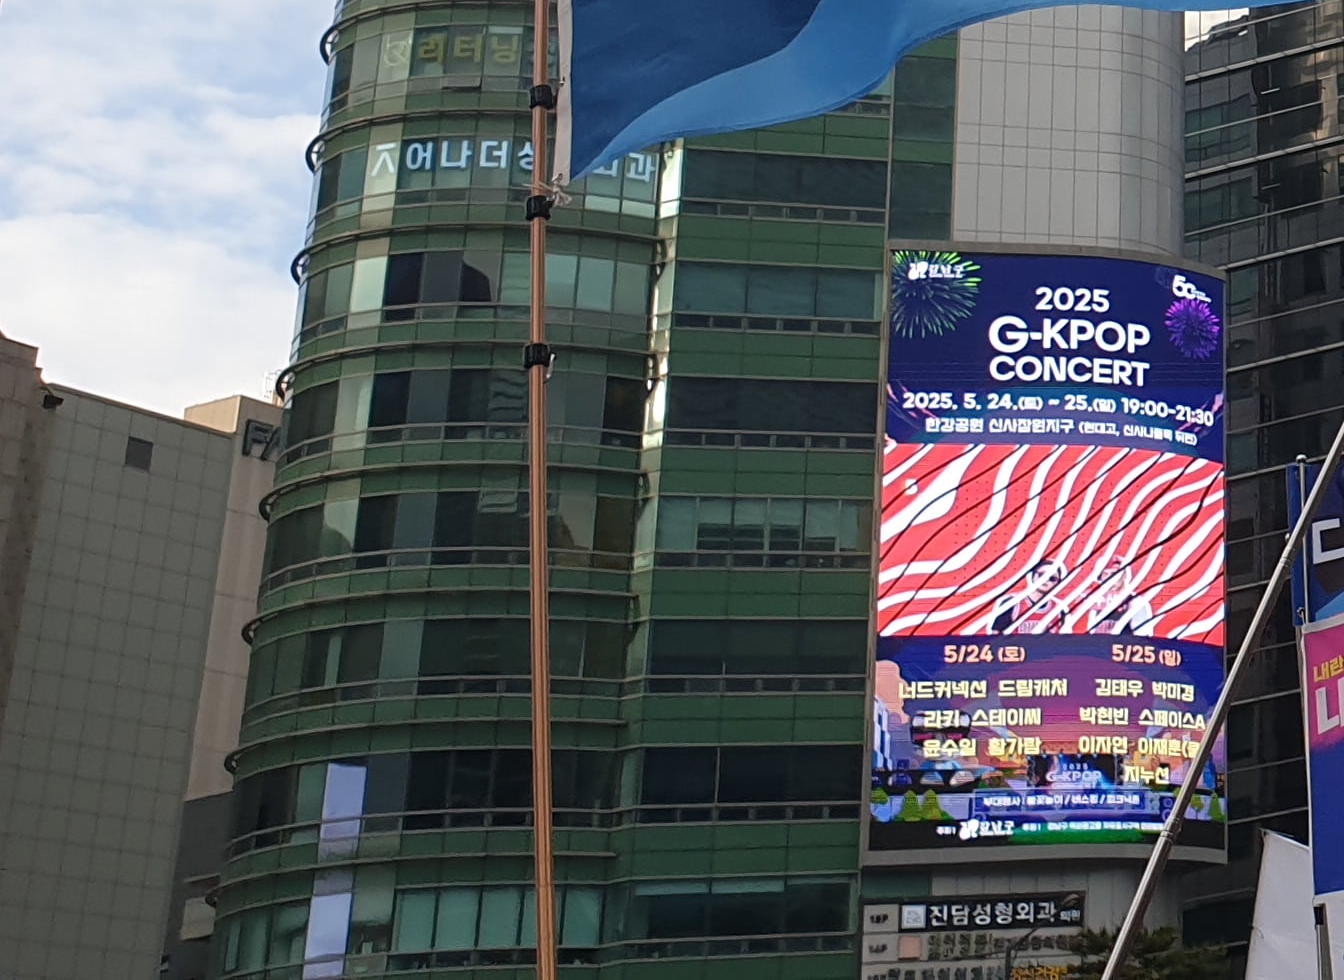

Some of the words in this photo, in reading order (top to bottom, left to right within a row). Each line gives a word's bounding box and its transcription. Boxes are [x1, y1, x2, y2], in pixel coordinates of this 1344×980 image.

[1034, 286, 1111, 313] 2025
[988, 315, 1151, 354] G-KPOP
[989, 355, 1150, 387] CONCERT
[902, 392, 958, 411] 2025.
[963, 393, 982, 411] 5.
[1121, 396, 1215, 427] 19:00-21:30
[925, 417, 984, 434] 한강공원
[943, 645, 994, 664] 5/24
[998, 645, 1026, 664] (토)
[1111, 644, 1156, 664] 5/25
[1159, 648, 1182, 666] (일)
[1095, 678, 1144, 698] 김태우
[1151, 680, 1195, 703] 박미경
[971, 707, 1042, 728] 스테이씨
[1079, 706, 1130, 726] 박현빈
[922, 736, 976, 758] 윤수일
[1078, 735, 1129, 755] 이자연
[929, 901, 1057, 927] 진담성형외과
